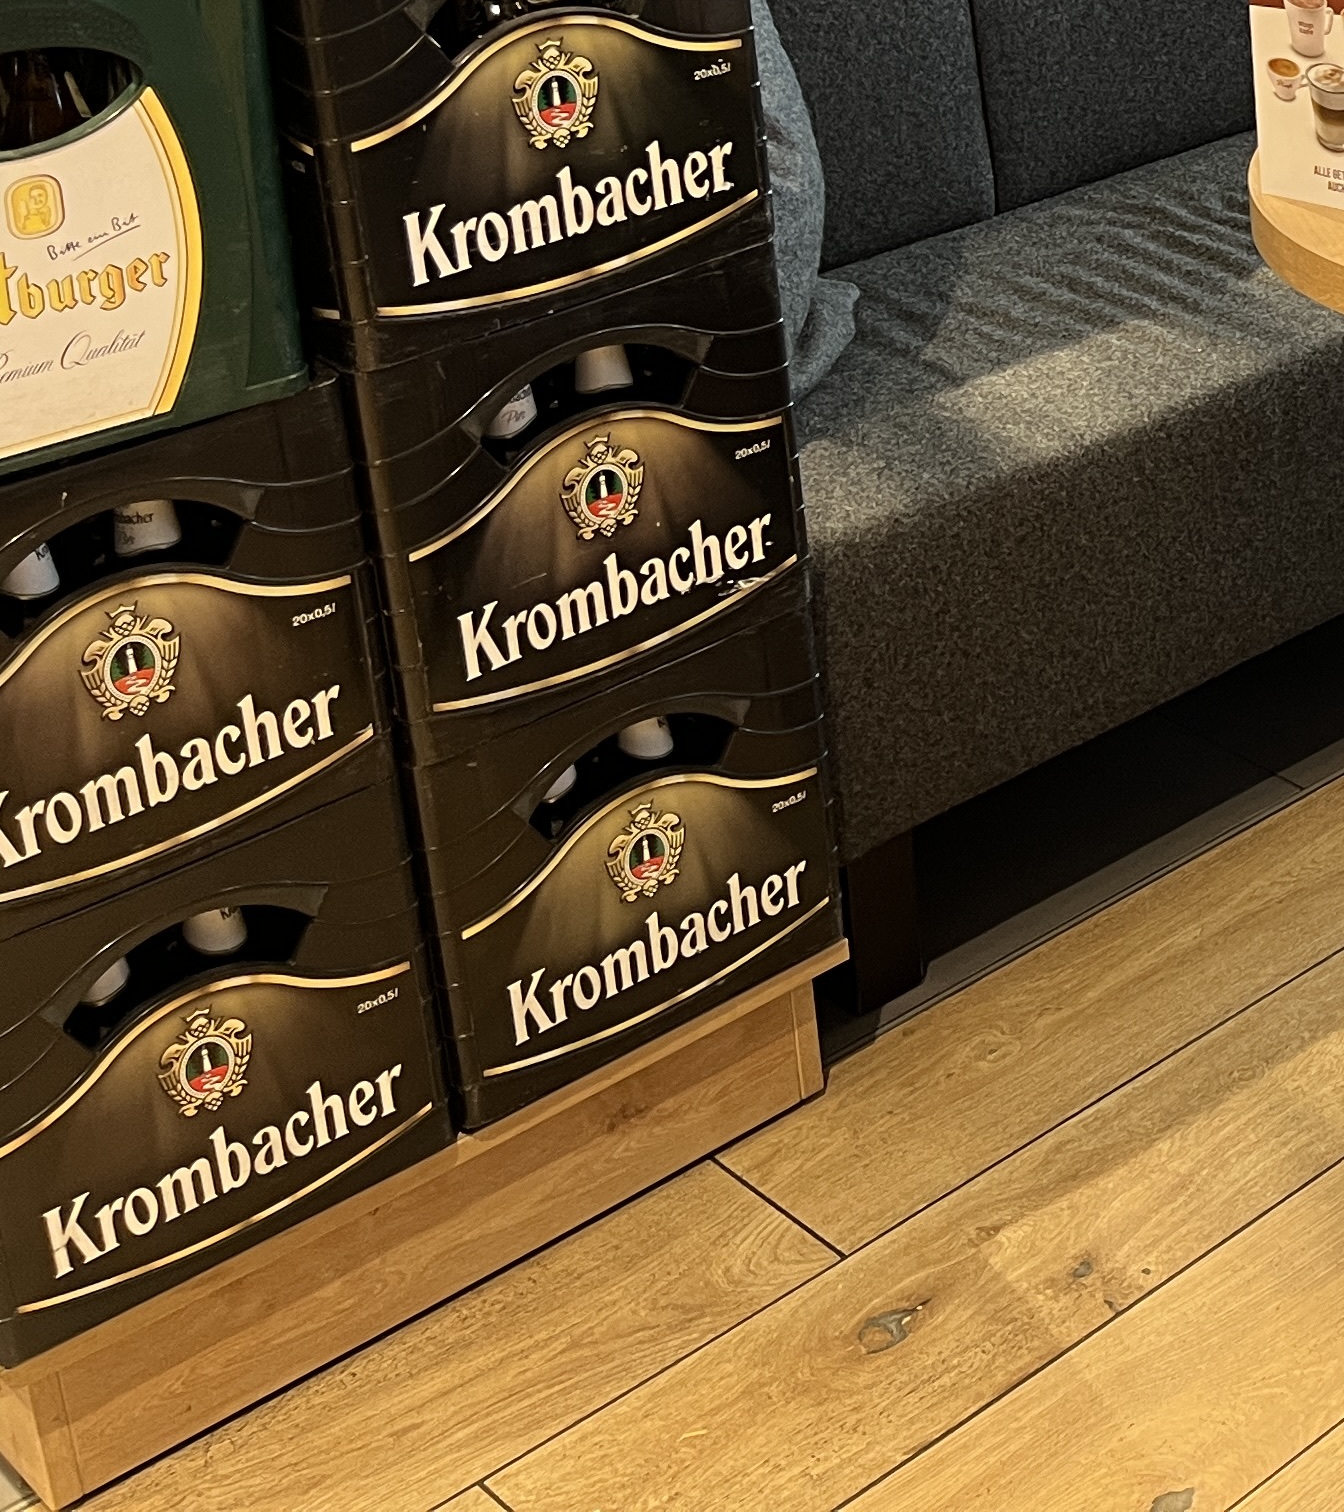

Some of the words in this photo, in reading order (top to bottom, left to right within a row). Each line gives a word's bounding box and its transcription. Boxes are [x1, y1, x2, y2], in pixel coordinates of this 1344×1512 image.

[0, 251, 170, 326] tburger
[403, 140, 735, 287] Krombacher
[60, 329, 146, 370] Qualität
[457, 513, 772, 682] Krombacher
[507, 860, 807, 1047] Krombacher
[42, 1063, 402, 1279] Krombacher
